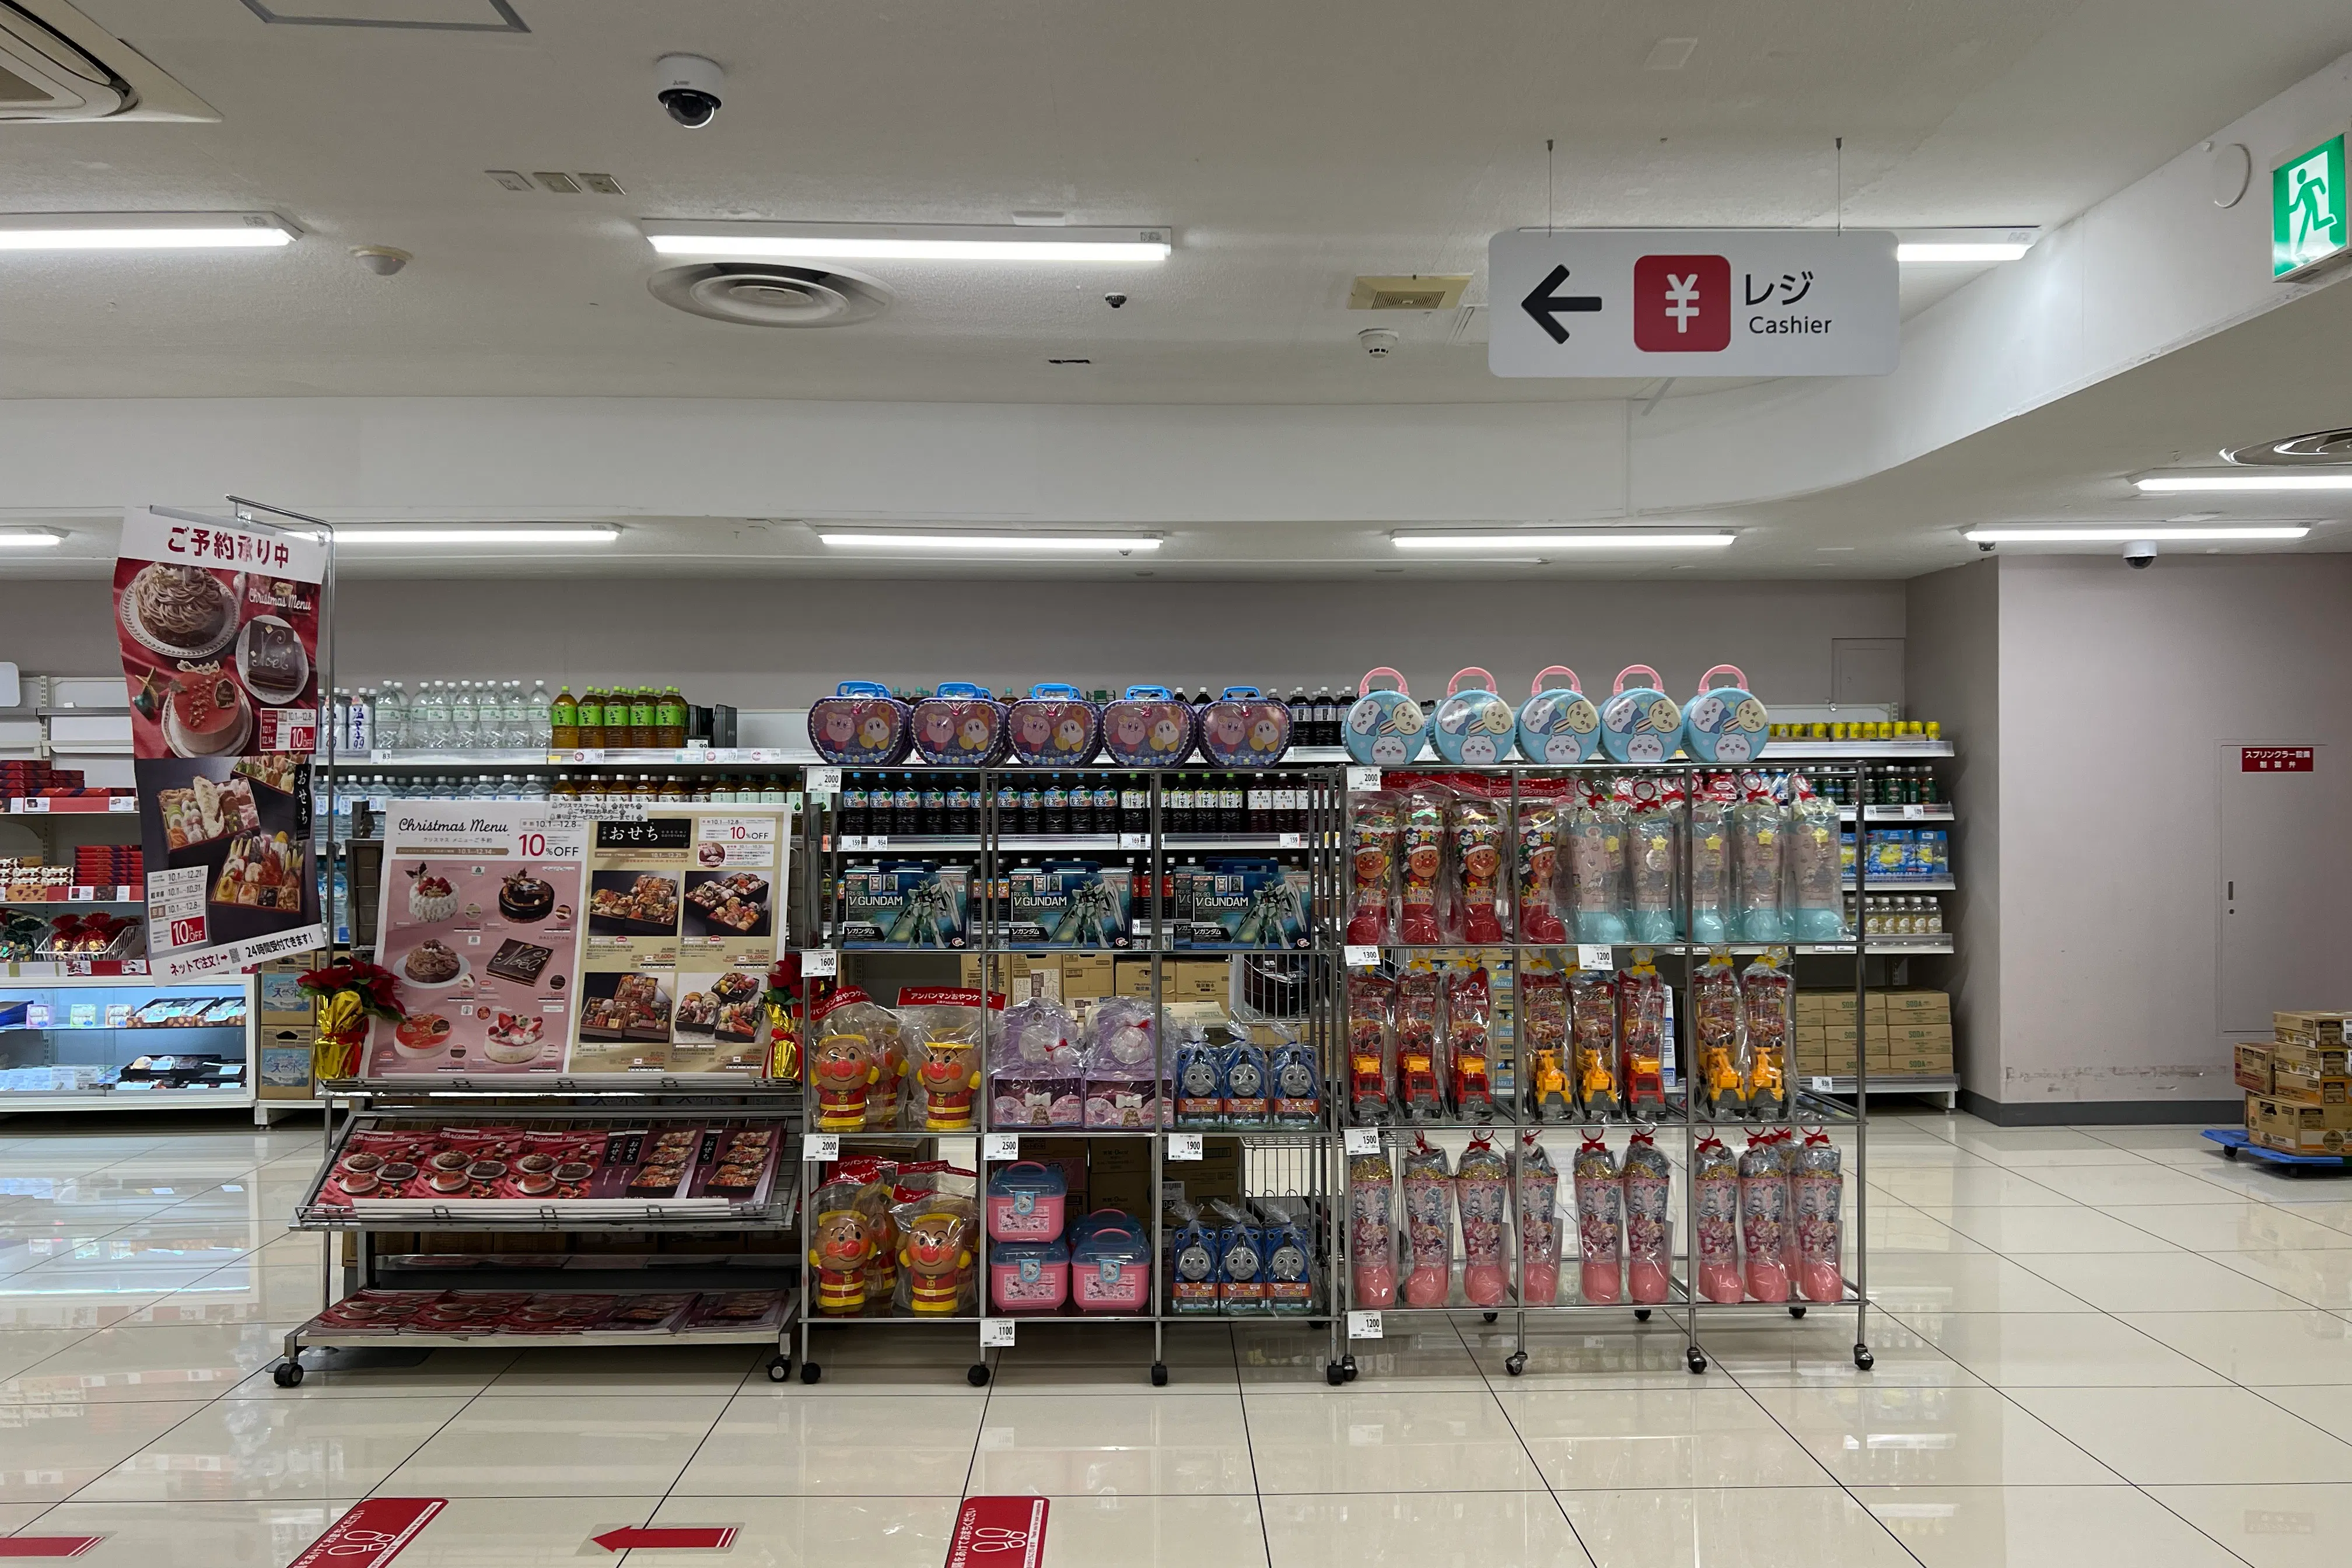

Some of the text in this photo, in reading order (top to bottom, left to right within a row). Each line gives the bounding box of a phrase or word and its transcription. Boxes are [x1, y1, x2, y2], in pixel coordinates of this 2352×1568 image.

[1745, 271, 1814, 306] レジ
[1749, 316, 1832, 335] Cashier
[168, 526, 289, 569] ご予約承り中
[249, 587, 312, 611] Christmas Menu
[824, 775, 839, 783] 2000
[1364, 774, 1378, 782] 2000
[297, 770, 309, 825] おせち
[398, 818, 508, 833] Christmas Menu
[610, 825, 658, 841] おせち
[858, 896, 903, 906] GUNDAM
[1023, 896, 1067, 906] GUNDAM
[1205, 897, 1249, 907] GUNDAM
[493, 944, 549, 972] Noël
[1596, 951, 1610, 961] 1200
[820, 957, 835, 966] 1600
[1044, 970, 1059, 998] 美味
[1906, 1000, 1922, 1008] SODA
[1908, 1030, 1925, 1038] SODA
[271, 1062, 302, 1073] 天然水
[1821, 1079, 1830, 1087] 936
[354, 1133, 393, 1142] Christmas
[440, 1132, 481, 1140] Christmas
[1363, 1135, 1377, 1144] 1500
[702, 1140, 714, 1160] おせち
[822, 1142, 836, 1150] 2000
[1002, 1141, 1016, 1150] 2500
[1186, 1140, 1200, 1150] 1900
[611, 1142, 622, 1162] おせち
[626, 1140, 637, 1161] おせち
[1366, 1318, 1380, 1328] 1200
[999, 1326, 1013, 1335] 1100
